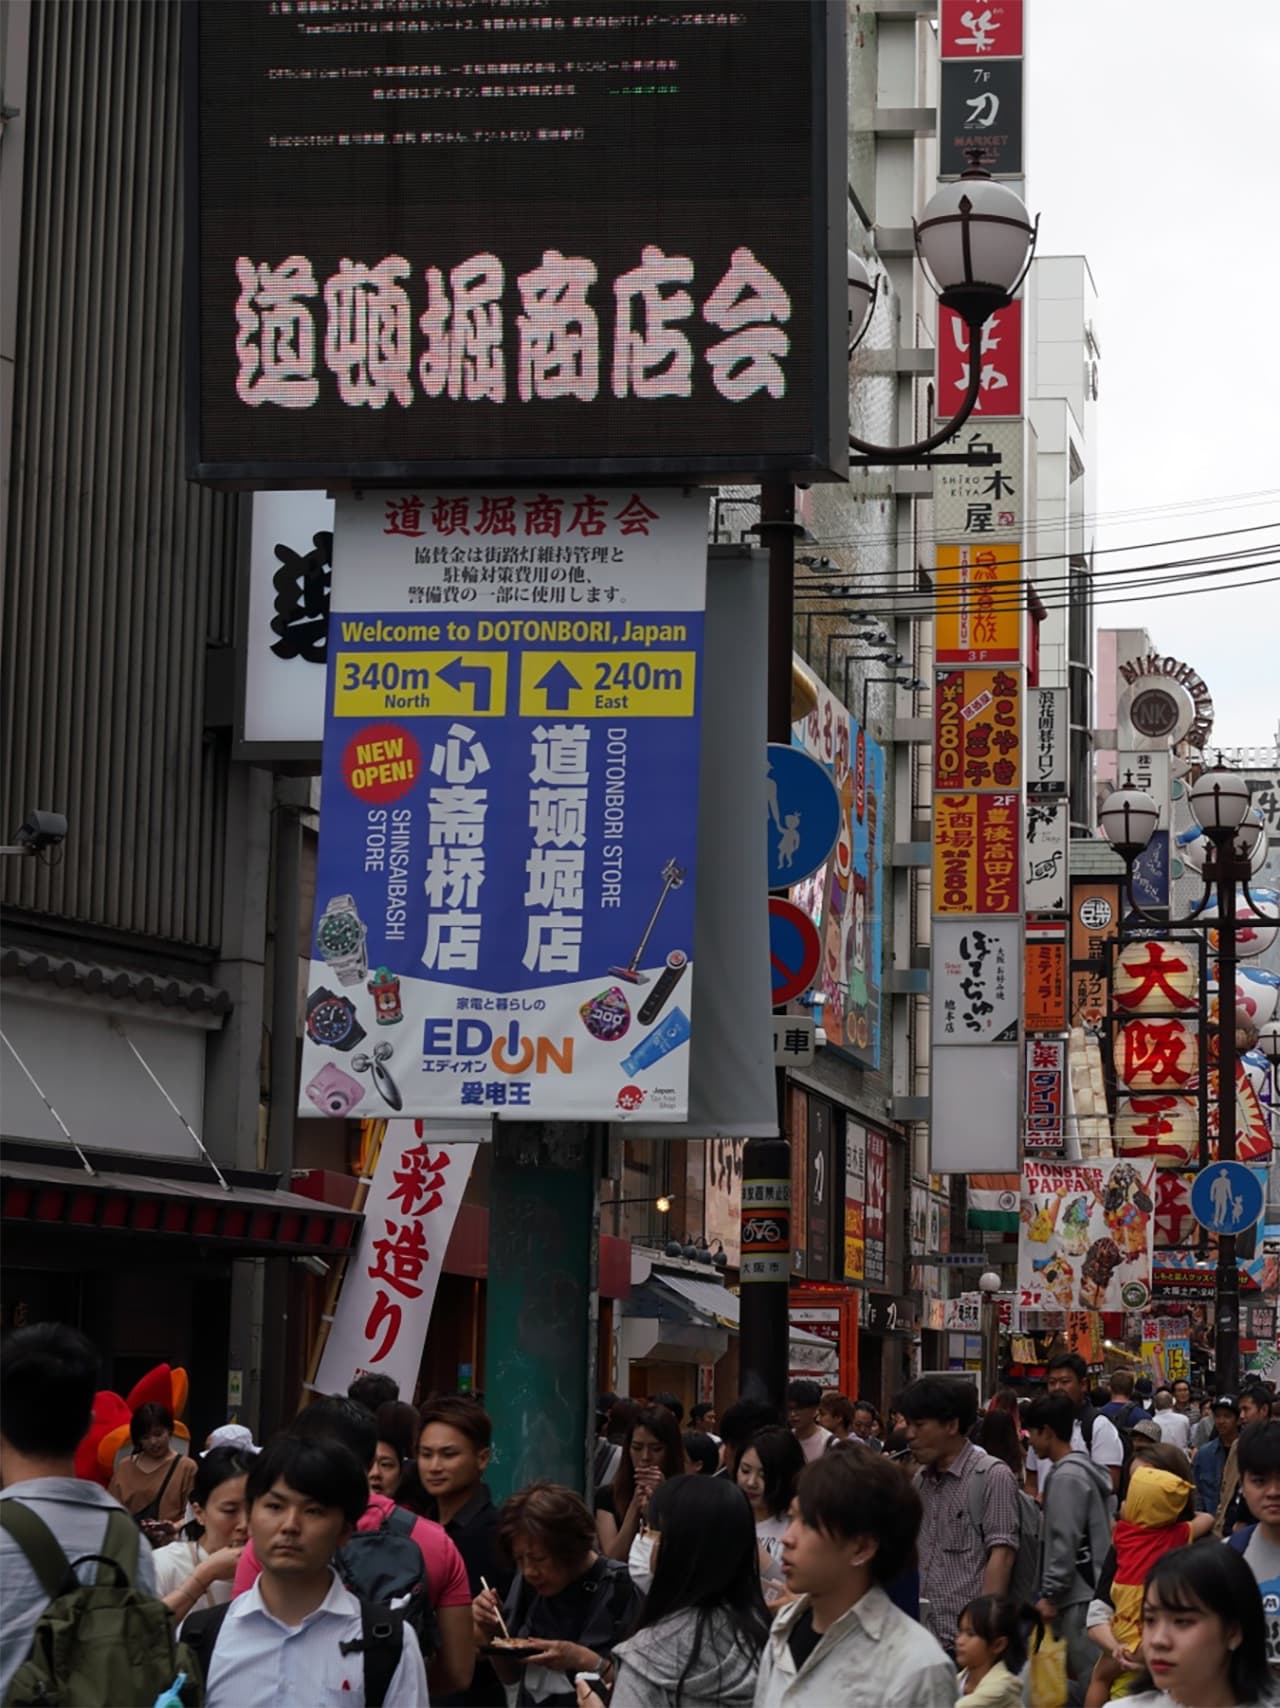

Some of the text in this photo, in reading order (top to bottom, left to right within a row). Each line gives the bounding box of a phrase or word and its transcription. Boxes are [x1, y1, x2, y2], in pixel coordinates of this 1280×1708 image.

[973, 69, 991, 83] 7F
[965, 92, 999, 126] 刀
[954, 135, 1008, 146] MARKET
[235, 245, 792, 409] 道頓堀商店会
[951, 487, 980, 497] KIYA
[383, 494, 660, 537] 道頓堀商店会
[414, 546, 624, 565] 協賛金は街路灯維持管理と
[443, 566, 593, 584] 駐輪対策費用の他、
[408, 586, 627, 604] 警備費の一部に使用します。
[342, 622, 440, 643] Welcome
[447, 623, 471, 642] to
[622, 621, 687, 647] Japan
[968, 652, 988, 661] 3F
[342, 661, 430, 691] 340m
[594, 661, 682, 691] 240m
[385, 694, 430, 709] North
[595, 694, 629, 709] East
[1118, 653, 1214, 750] NIKOH BLDG
[1140, 703, 1168, 725] NK
[992, 670, 1019, 786] たこやき
[355, 739, 404, 766] NEW
[350, 759, 414, 790] OPEN!
[1033, 783, 1057, 791] 4F
[993, 796, 1016, 806] 2F
[601, 727, 628, 909] DOTONBORI STORE
[935, 811, 977, 847] 酒場
[364, 809, 387, 872] STORE
[421, 722, 491, 971] 心斋桥店
[522, 724, 591, 973] 道顿堀店
[983, 808, 1016, 912] 豊後高田どり
[384, 809, 412, 941] SHINSAIBASHI
[943, 859, 968, 904] 280
[456, 998, 546, 1012] 家電と暮らしの
[422, 1018, 574, 1075] EDION
[1003, 1031, 1016, 1040] 2F
[422, 1059, 487, 1073] エディオン
[1033, 1072, 1056, 1130] ダイコク
[1027, 1132, 1062, 1147] 免税
[1024, 1162, 1103, 1179] MONSTER
[743, 1262, 781, 1274] 大阪市
